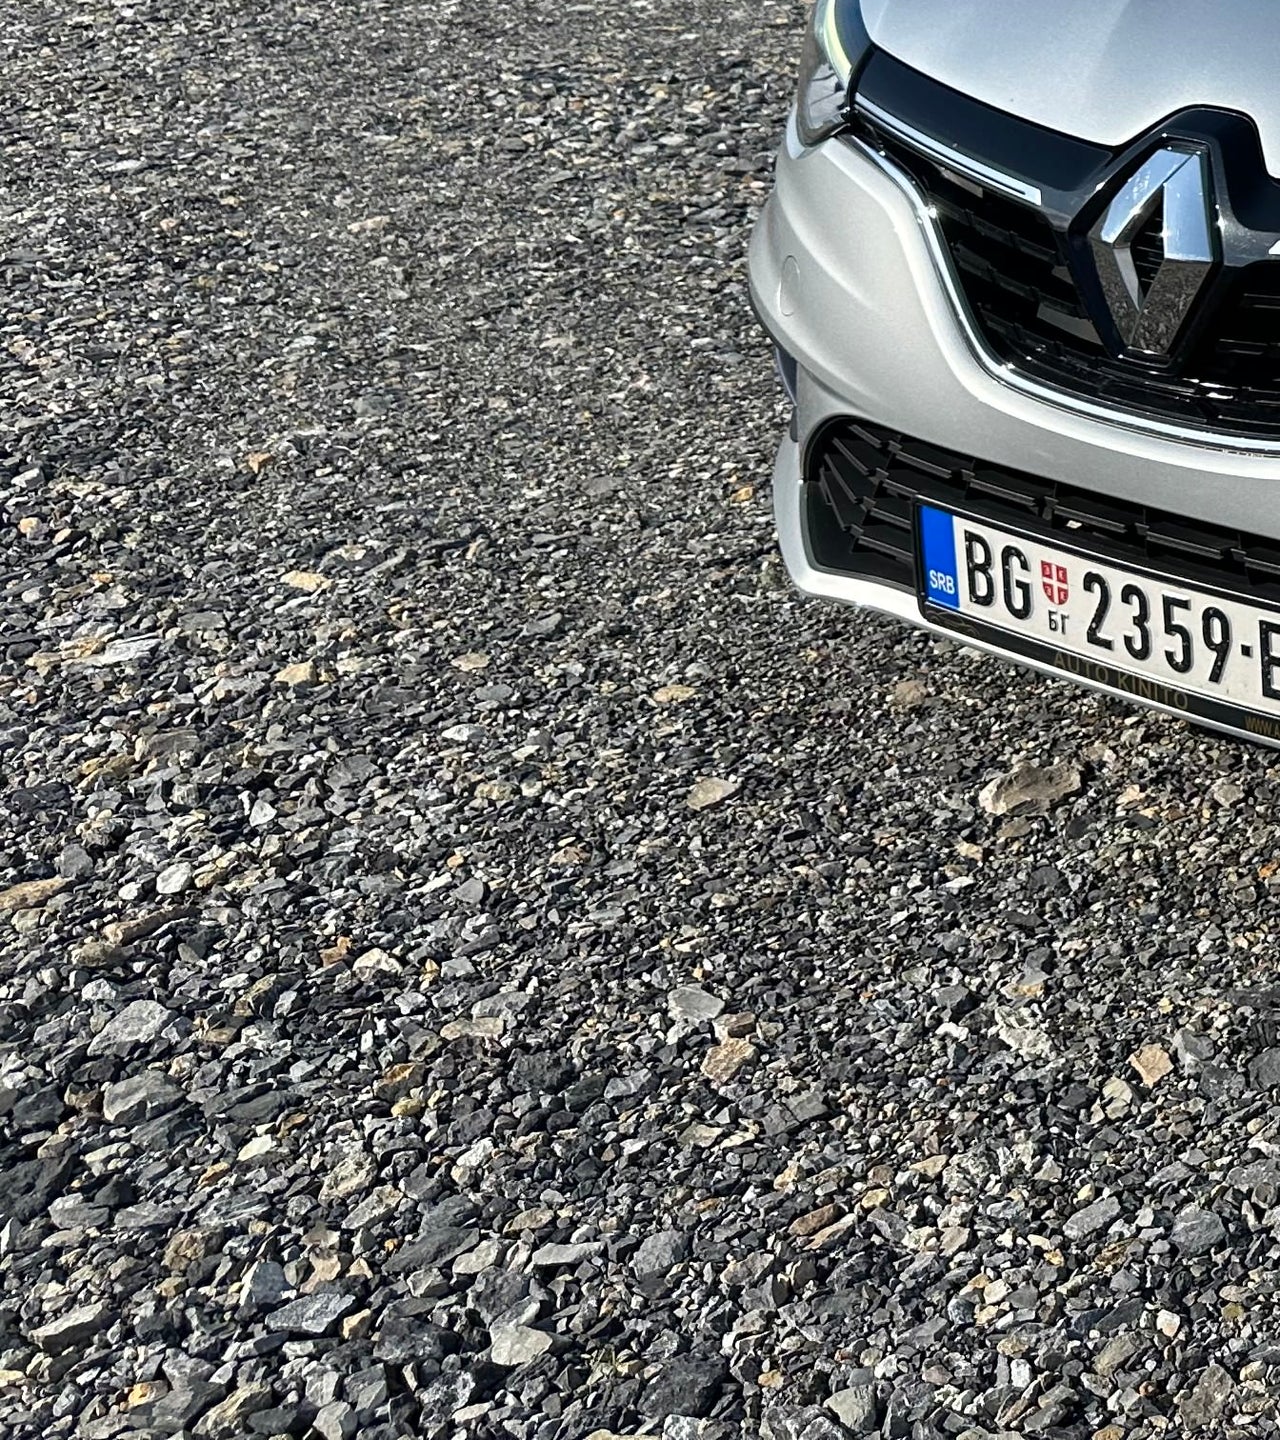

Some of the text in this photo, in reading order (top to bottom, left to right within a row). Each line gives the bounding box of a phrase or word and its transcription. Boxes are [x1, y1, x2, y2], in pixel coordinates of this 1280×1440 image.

[929, 569, 956, 595] SRB
[964, 528, 1035, 620] BG
[1053, 650, 1189, 711] AUTO KINITO
